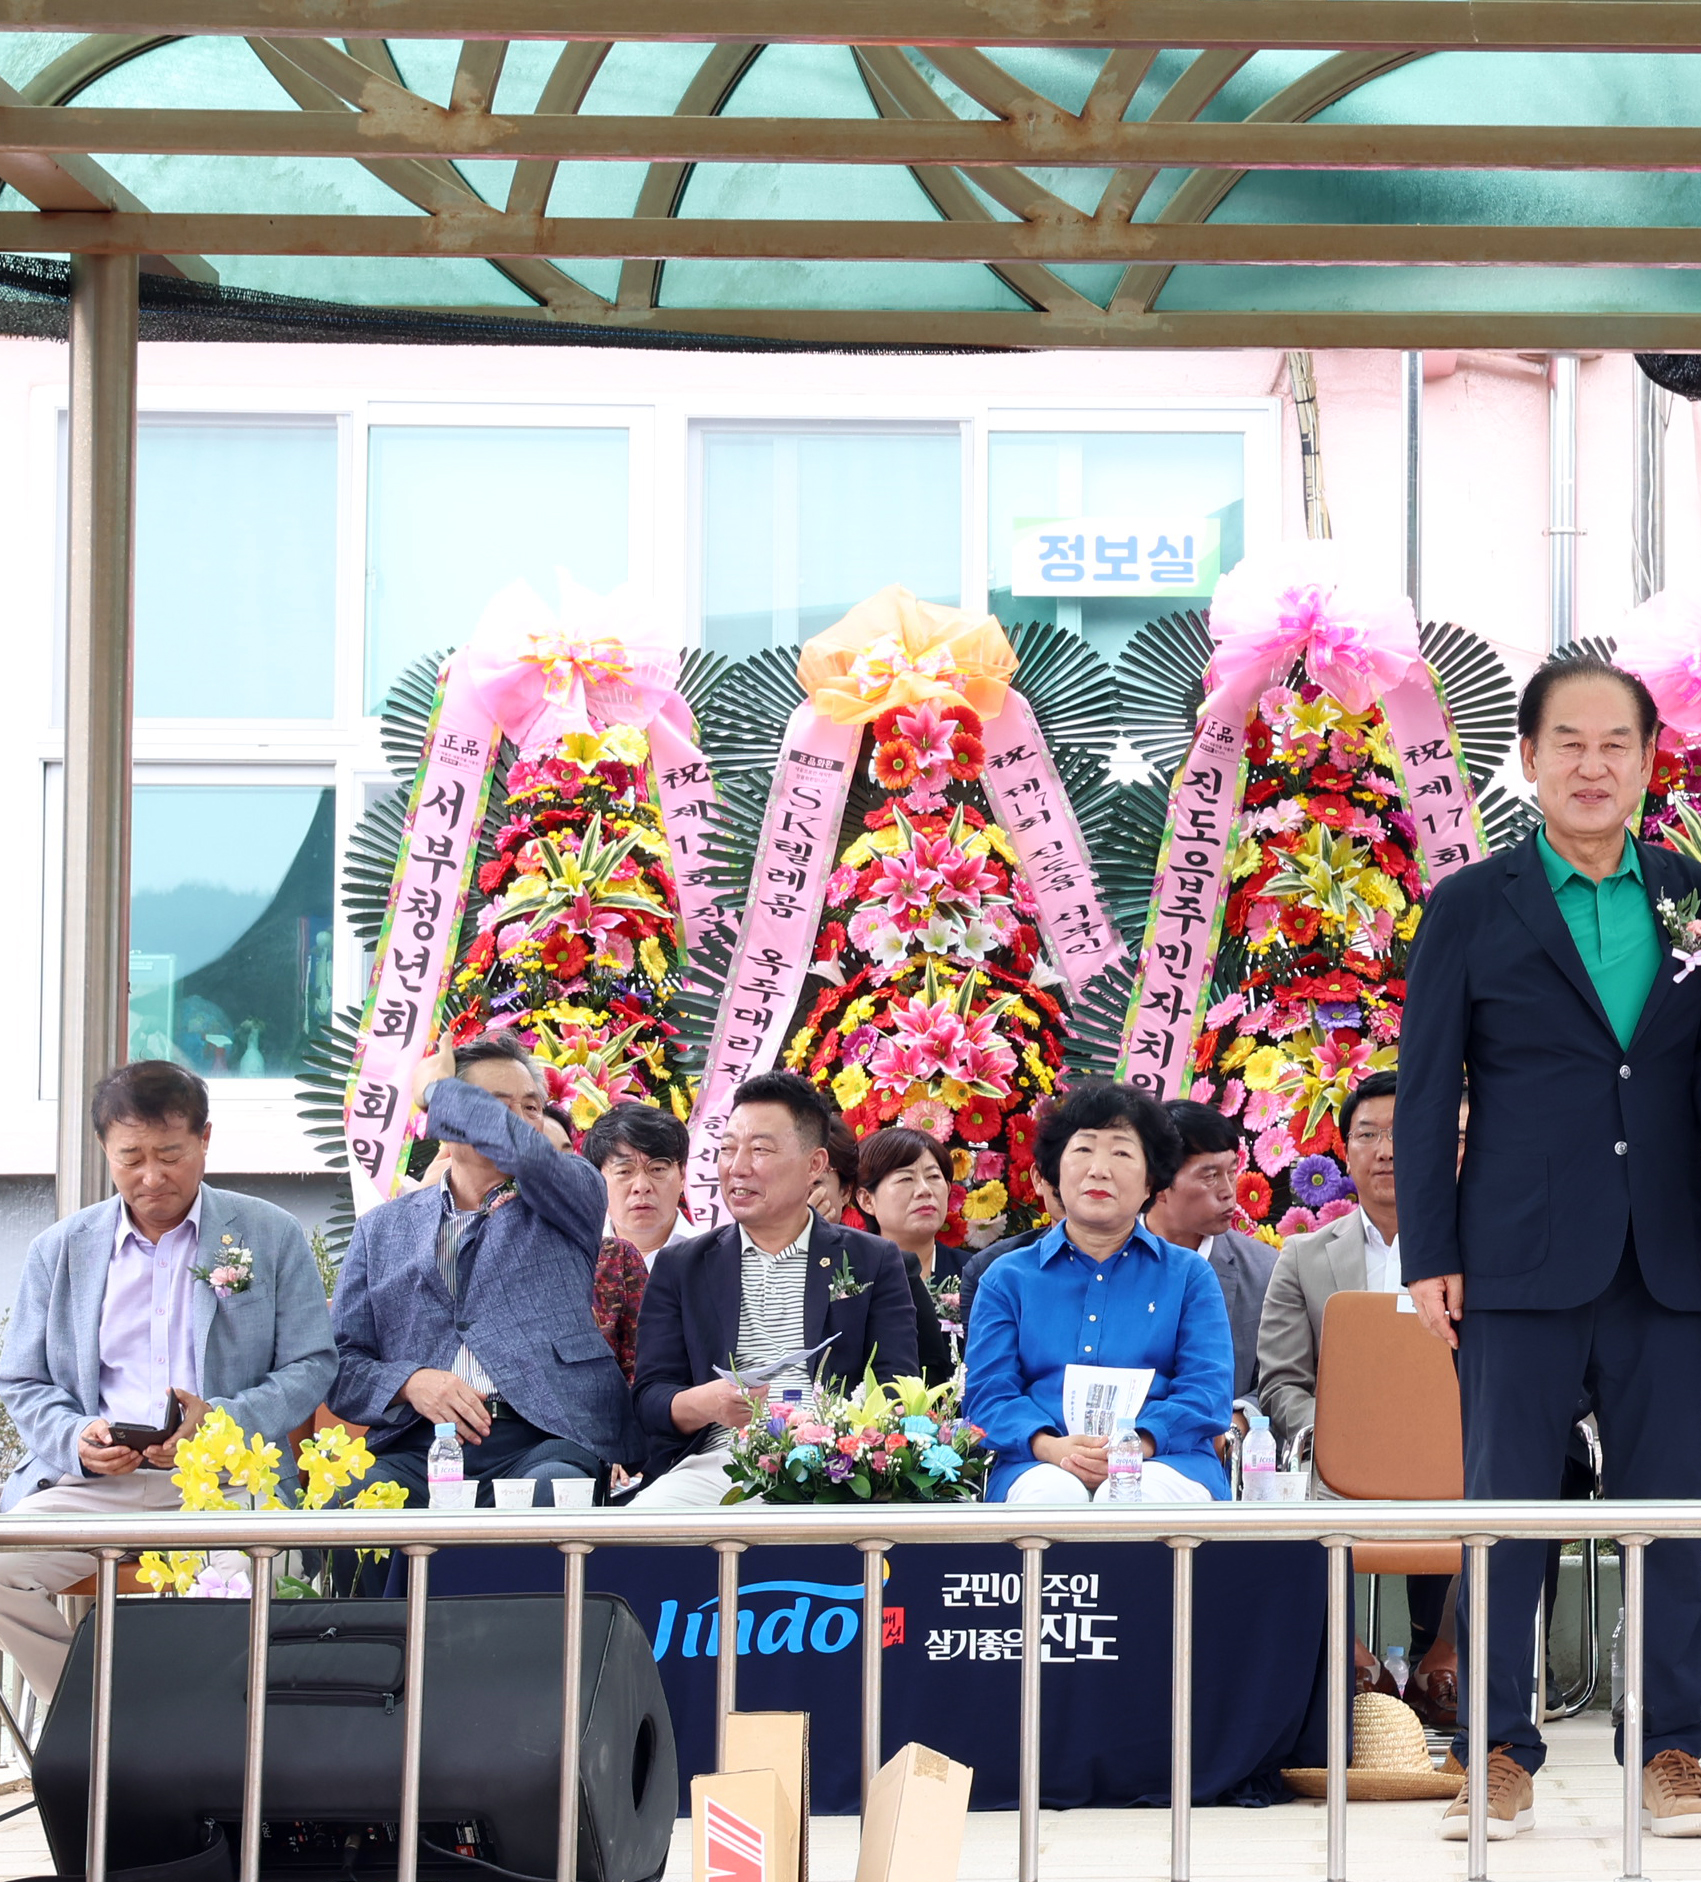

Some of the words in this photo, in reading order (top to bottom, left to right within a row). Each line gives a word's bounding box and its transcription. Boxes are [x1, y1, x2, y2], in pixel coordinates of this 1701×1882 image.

[1038, 534, 1194, 582] 정보실
[439, 733, 480, 757] 正品
[988, 745, 1038, 769] 祝
[1205, 721, 1234, 743] 正品
[1404, 740, 1453, 766] 祝
[661, 763, 711, 789] 祝
[1000, 777, 1051, 833] 제17회
[1414, 776, 1470, 867] 제17회
[760, 787, 822, 918] SK텔레콤
[1026, 840, 1084, 893] 진도읍
[373, 780, 465, 1050] 서부청년회
[1050, 904, 1103, 955] 서부인
[716, 949, 793, 1085] 옥주대리점
[941, 1573, 1024, 1608] 군민이
[1041, 1573, 1099, 1608] 주인
[654, 1596, 859, 1663] Jindo
[924, 1628, 1023, 1661] 살기좋은
[1041, 1614, 1120, 1664] 진도
